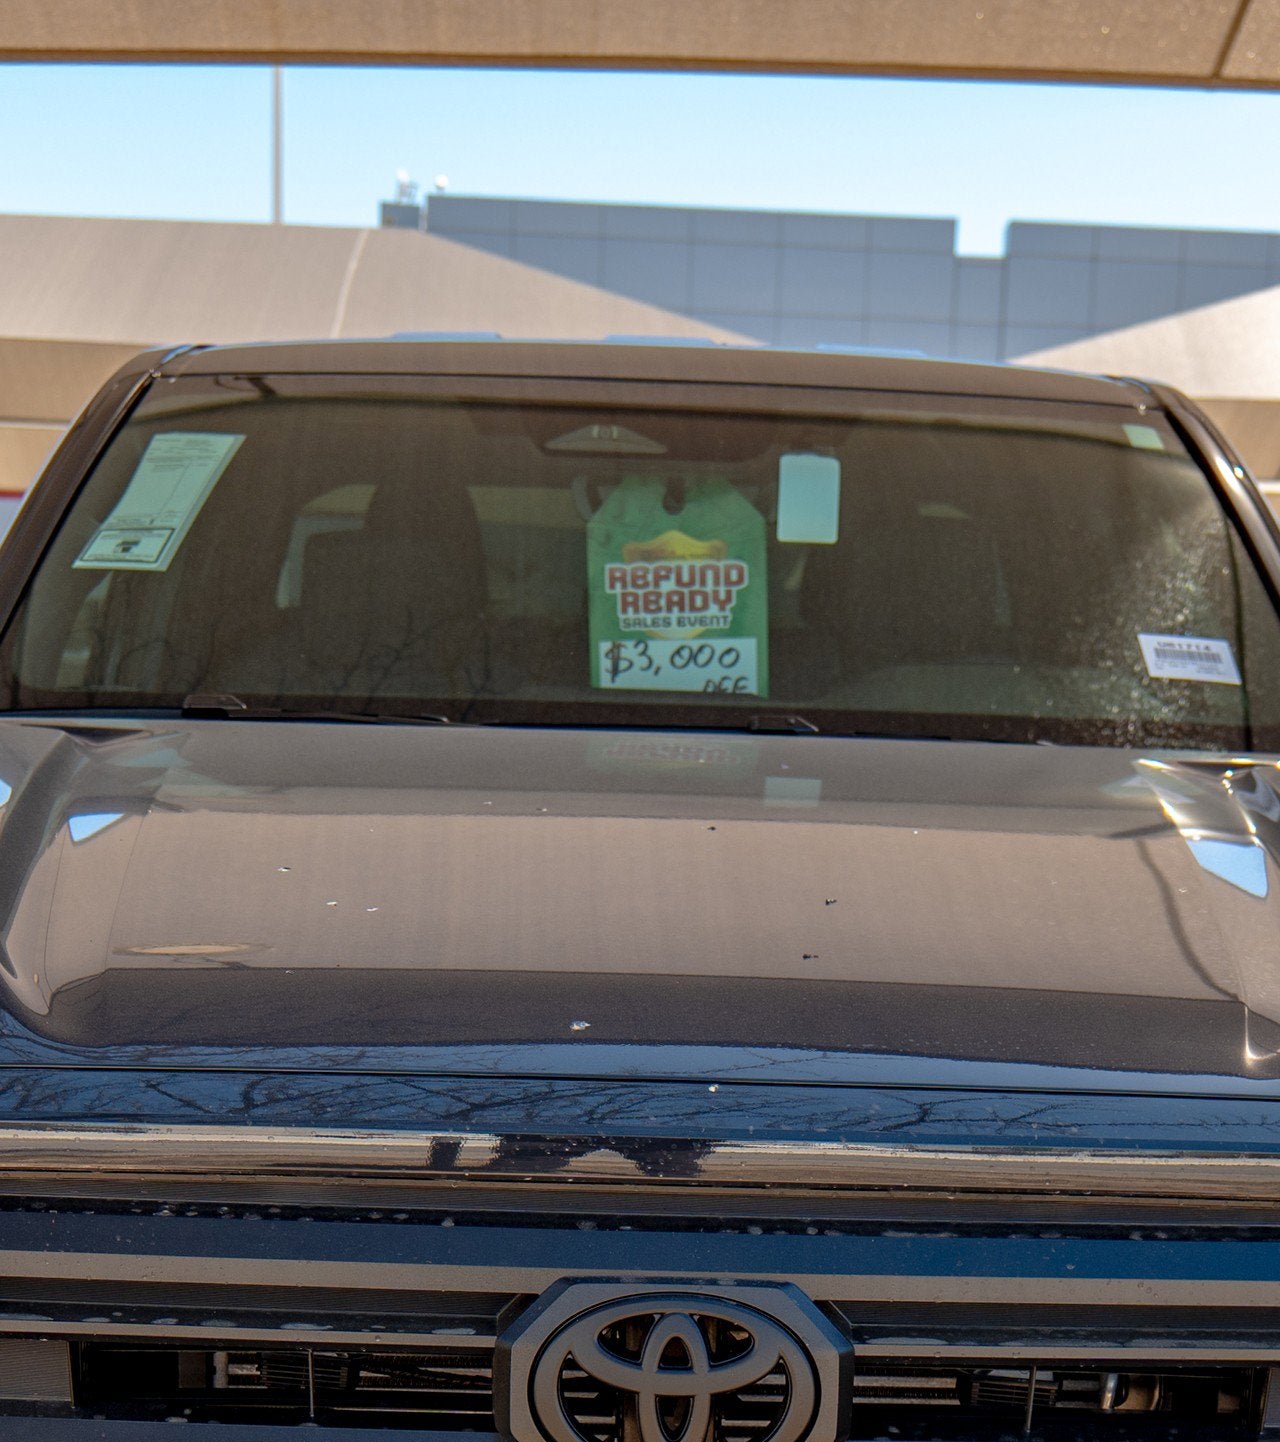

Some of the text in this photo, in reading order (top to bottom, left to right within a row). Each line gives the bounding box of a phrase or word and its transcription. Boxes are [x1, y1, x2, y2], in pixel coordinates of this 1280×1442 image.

[607, 563, 747, 590] REFUND
[621, 589, 733, 615] READY
[622, 615, 730, 629] SALES EVENT
[604, 640, 741, 683] $3,000
